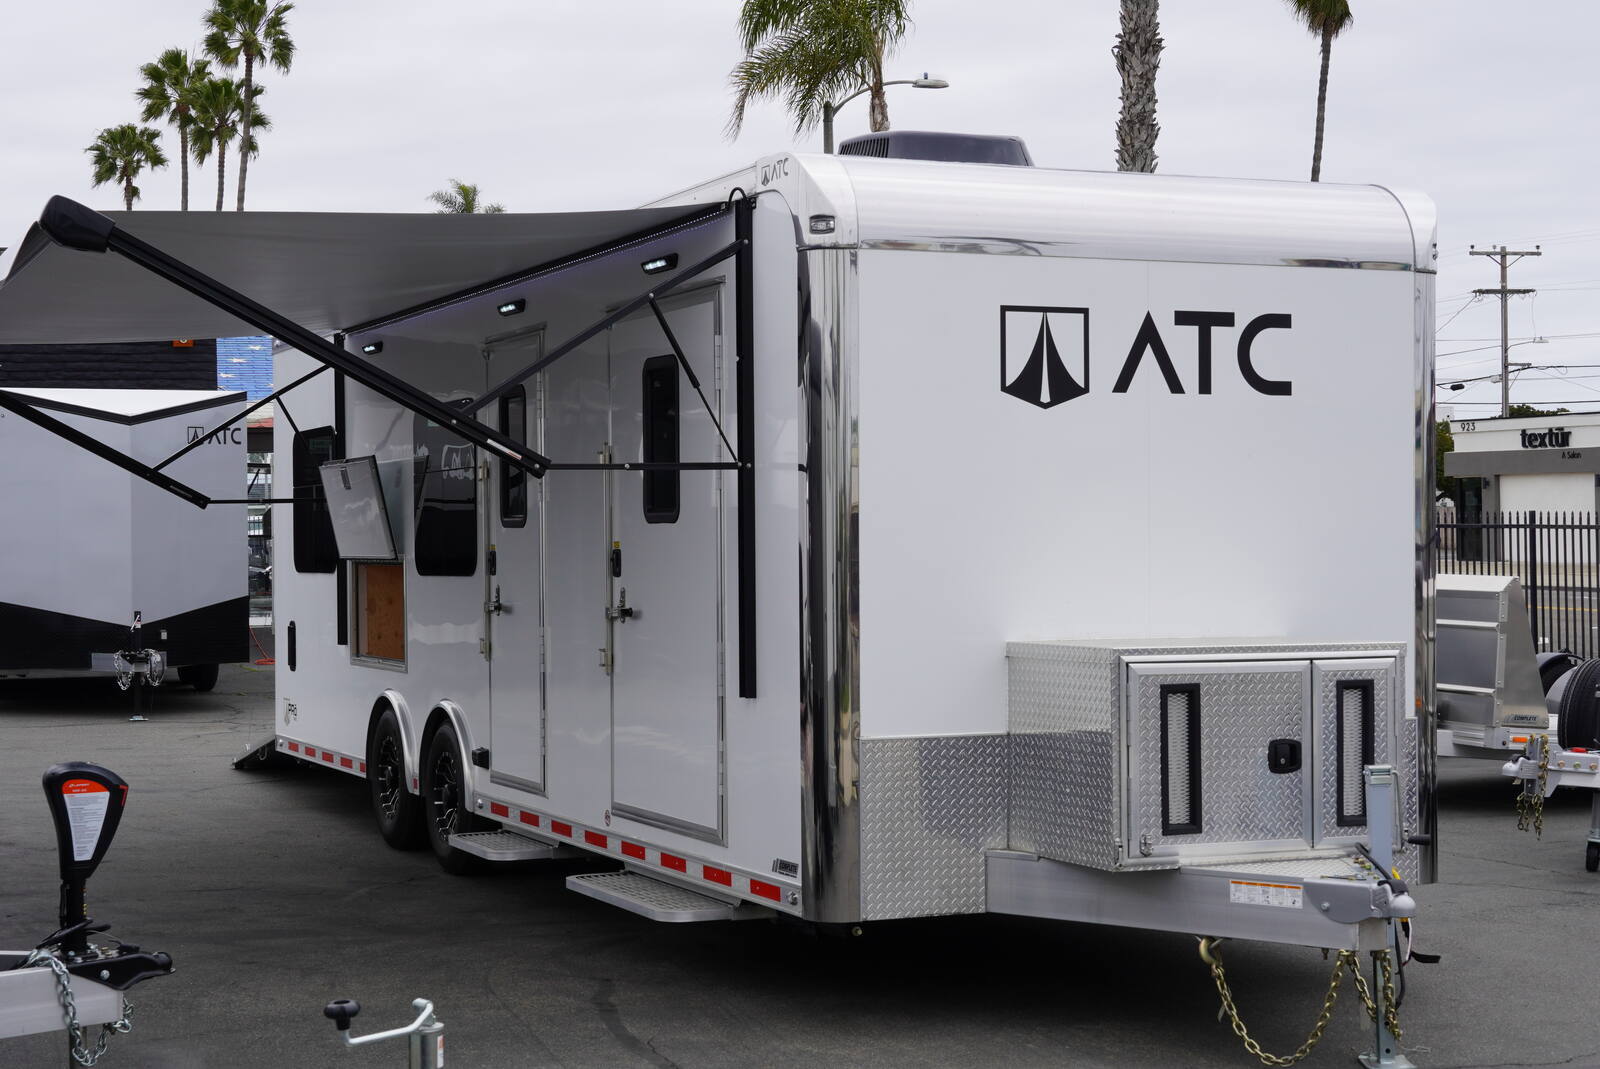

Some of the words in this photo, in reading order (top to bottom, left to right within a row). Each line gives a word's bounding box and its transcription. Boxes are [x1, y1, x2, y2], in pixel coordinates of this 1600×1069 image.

[771, 157, 789, 181] ATC
[1112, 310, 1292, 396] ATC
[207, 427, 242, 445] ATC
[1461, 422, 1476, 432] 923
